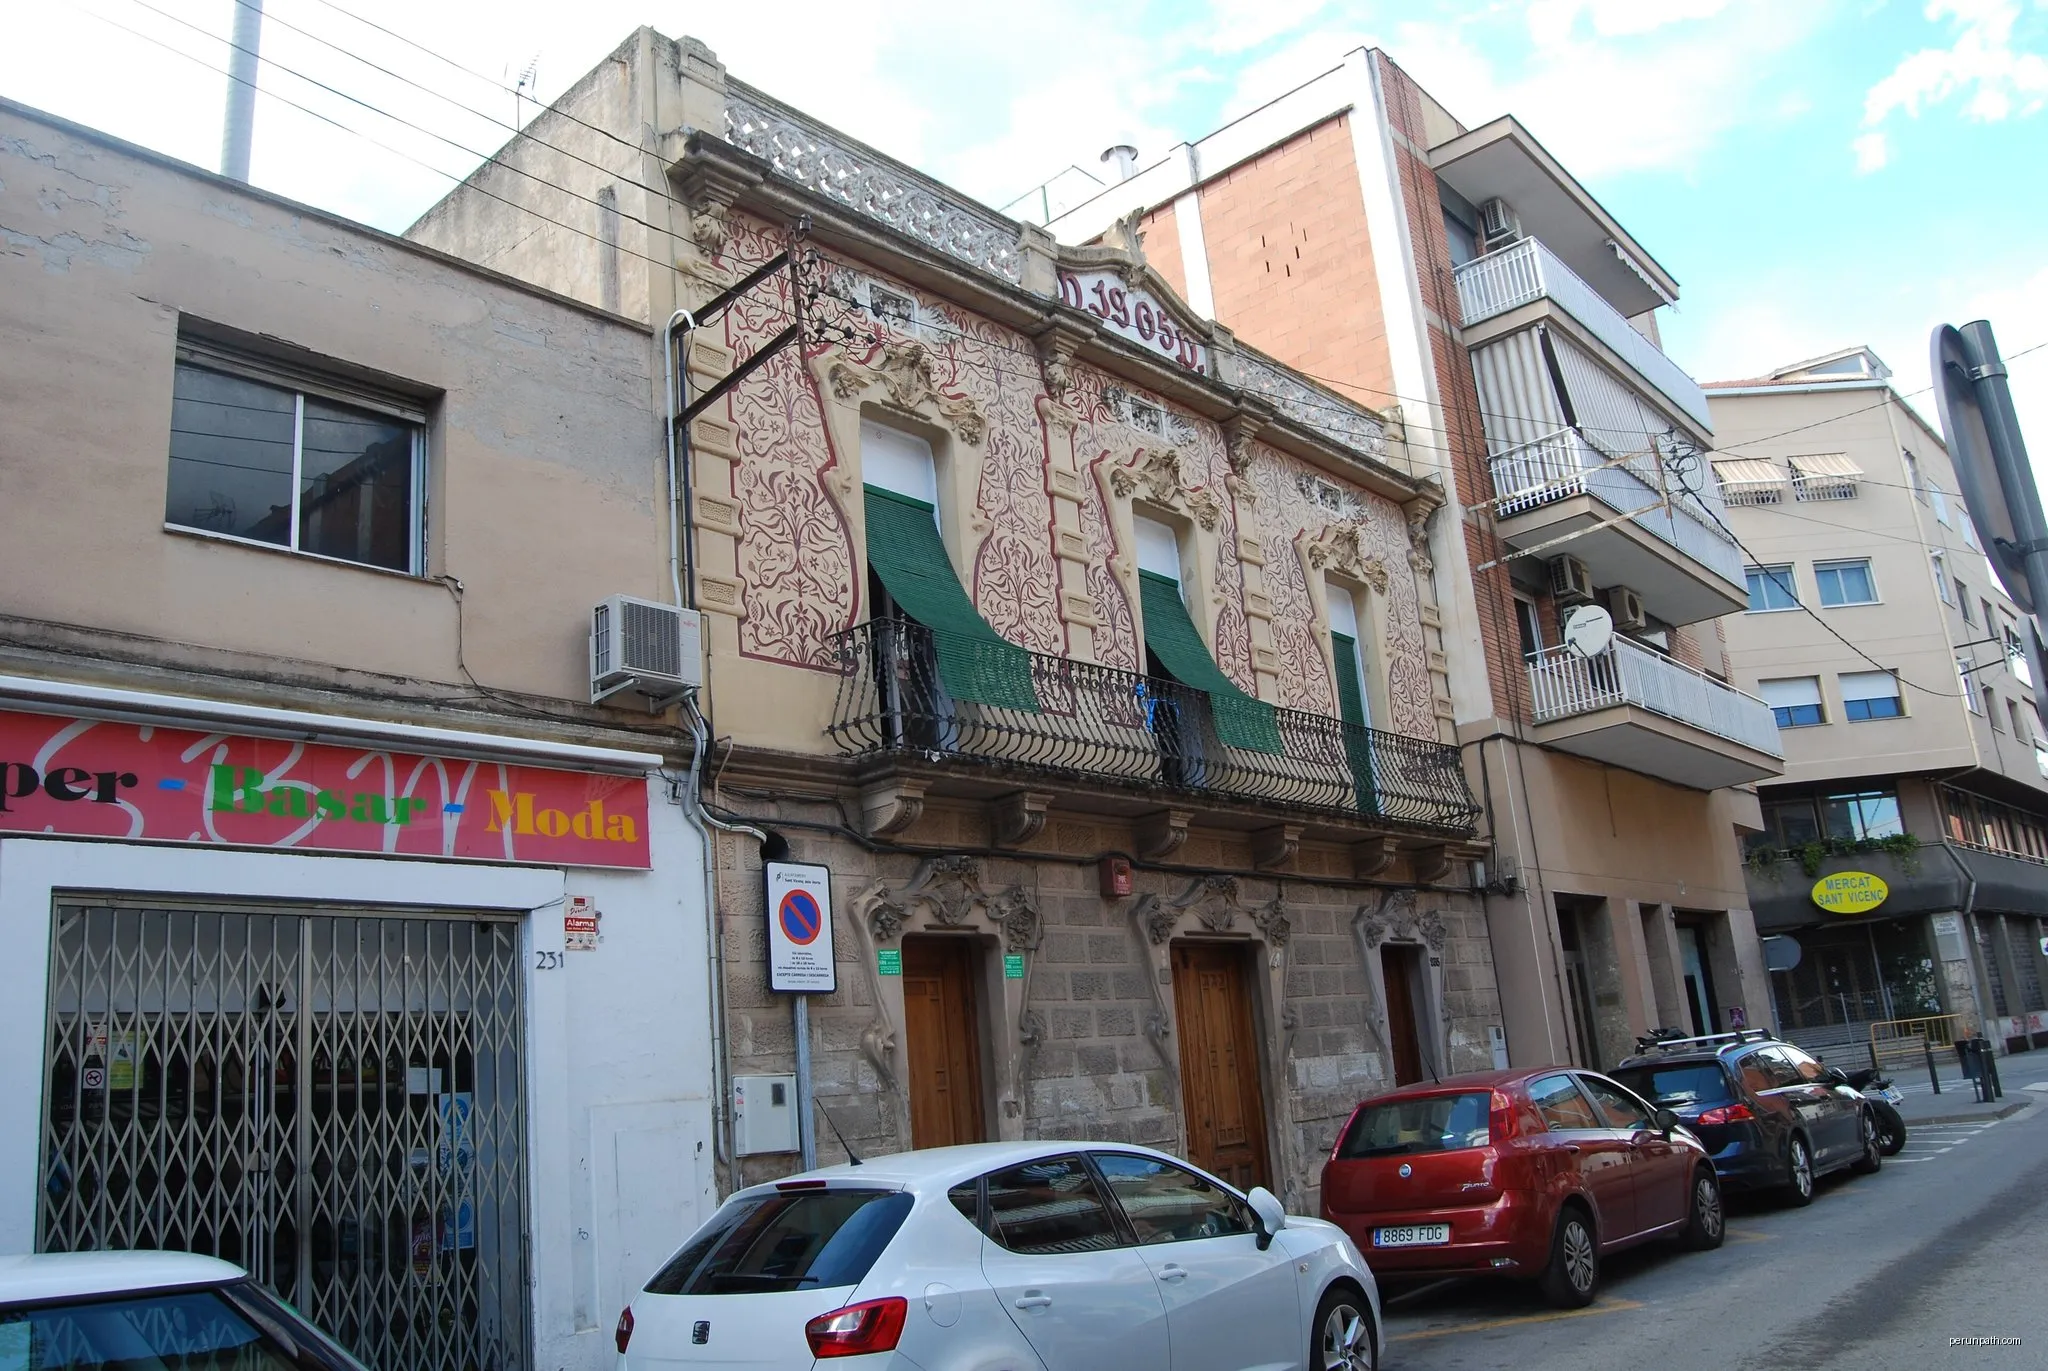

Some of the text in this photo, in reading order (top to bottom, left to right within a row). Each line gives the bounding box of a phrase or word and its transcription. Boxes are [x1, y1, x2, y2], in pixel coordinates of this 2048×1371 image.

[207, 763, 427, 826] Basar
[484, 788, 639, 843] Moda
[1825, 876, 1871, 890] MERCAT
[1818, 892, 1843, 906] SANT
[566, 918, 595, 928] Alarma
[535, 950, 564, 970] 231
[1383, 1226, 1443, 1244] 8869 FDG
